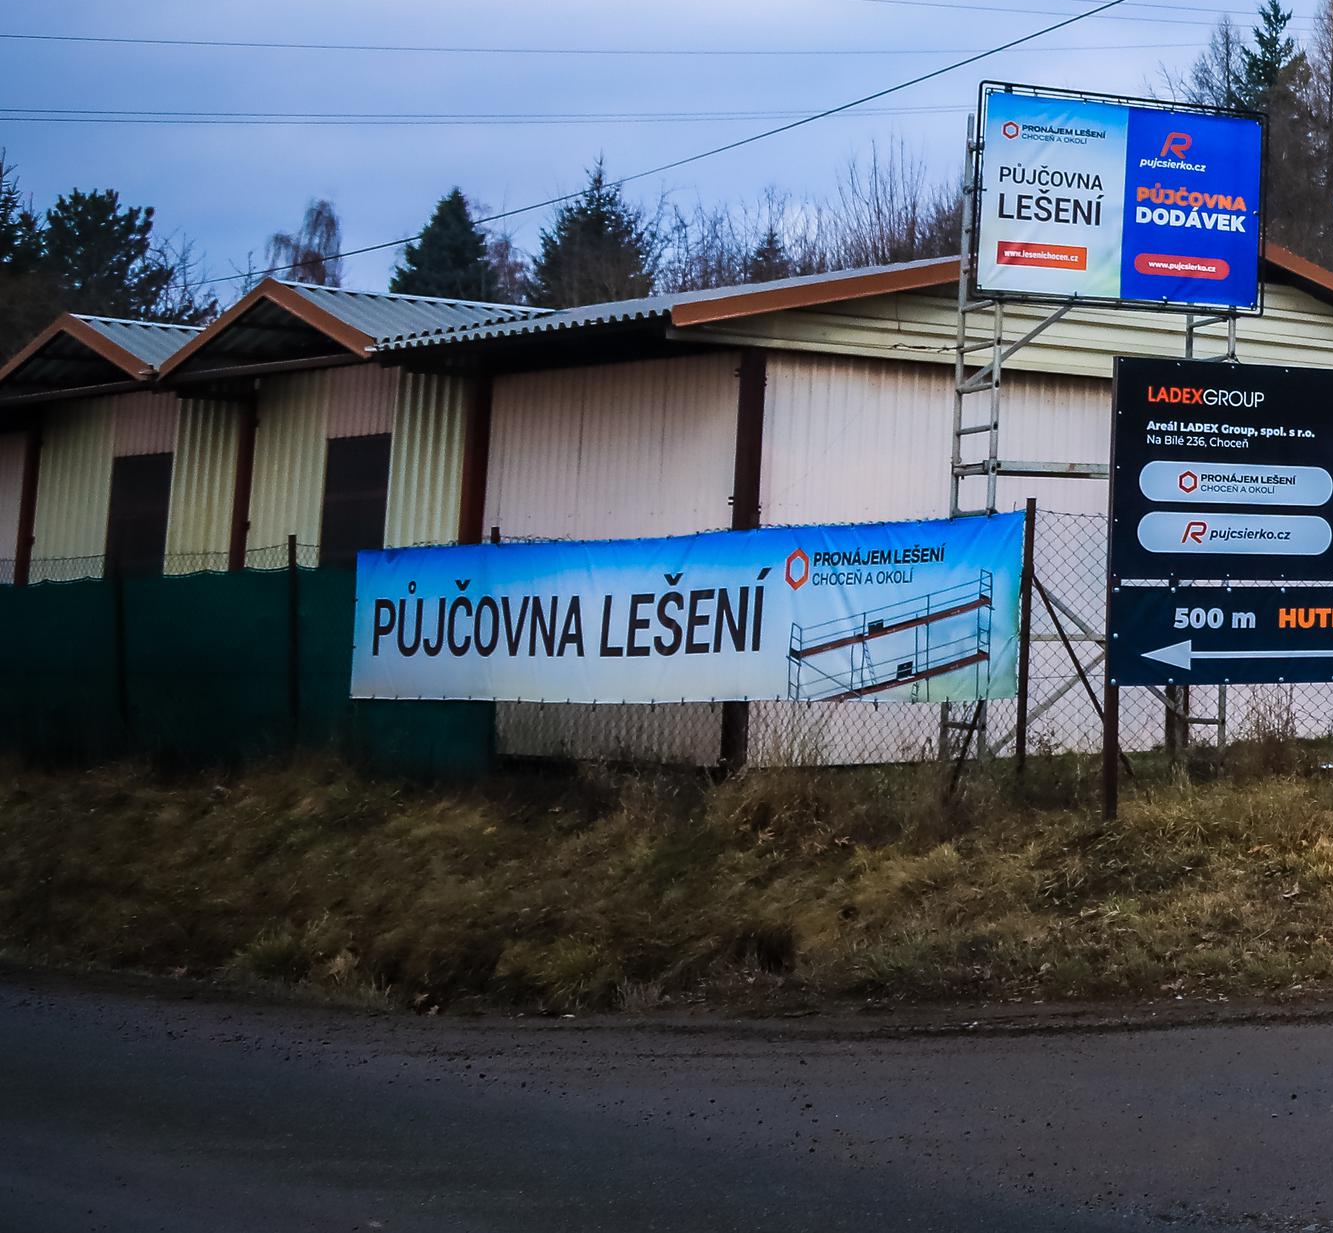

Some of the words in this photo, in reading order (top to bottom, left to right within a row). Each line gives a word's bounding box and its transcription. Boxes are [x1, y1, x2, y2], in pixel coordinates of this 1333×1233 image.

[1022, 124, 1073, 135] PRONÁJEM
[1074, 129, 1106, 139] LEŠENÍ
[1139, 157, 1206, 172] pujcsierko.cz
[999, 163, 1103, 191] PŮJČOVNA
[1136, 183, 1247, 211] PŮJČOVNA
[998, 189, 1104, 226] LEŠENÍ
[1136, 206, 1246, 233] DODÁVEK
[1148, 386, 1265, 408] LADEXGROUP
[1146, 420, 1178, 431] Areál
[1180, 422, 1219, 433] LADEX
[1221, 424, 1258, 437] Group,
[1260, 426, 1287, 438] spol.
[1289, 429, 1295, 437] s
[1297, 429, 1315, 438] r.o.
[1146, 434, 1161, 445] Na
[1165, 435, 1184, 445] Bílé
[1186, 436, 1207, 448] 236,
[1209, 437, 1249, 448] Choceň
[1201, 473, 1259, 484] PRONÁJEM
[1261, 474, 1296, 485] LEŠENÍ
[1201, 484, 1238, 493] CHOCEŇ
[1248, 485, 1275, 494] OKOLÍ
[1209, 527, 1291, 541] pujcsierko.cz
[813, 547, 891, 567] PRONÁJEM
[893, 543, 946, 564] LEŠENÍ
[812, 569, 862, 586] CHOCEŇ
[864, 573, 873, 585] A
[876, 567, 914, 585] OKOLÍ
[372, 579, 585, 657] PŮJČOVNA
[600, 567, 772, 657] LEŠENÍ
[1174, 607, 1224, 630] 500
[1231, 610, 1256, 629] m
